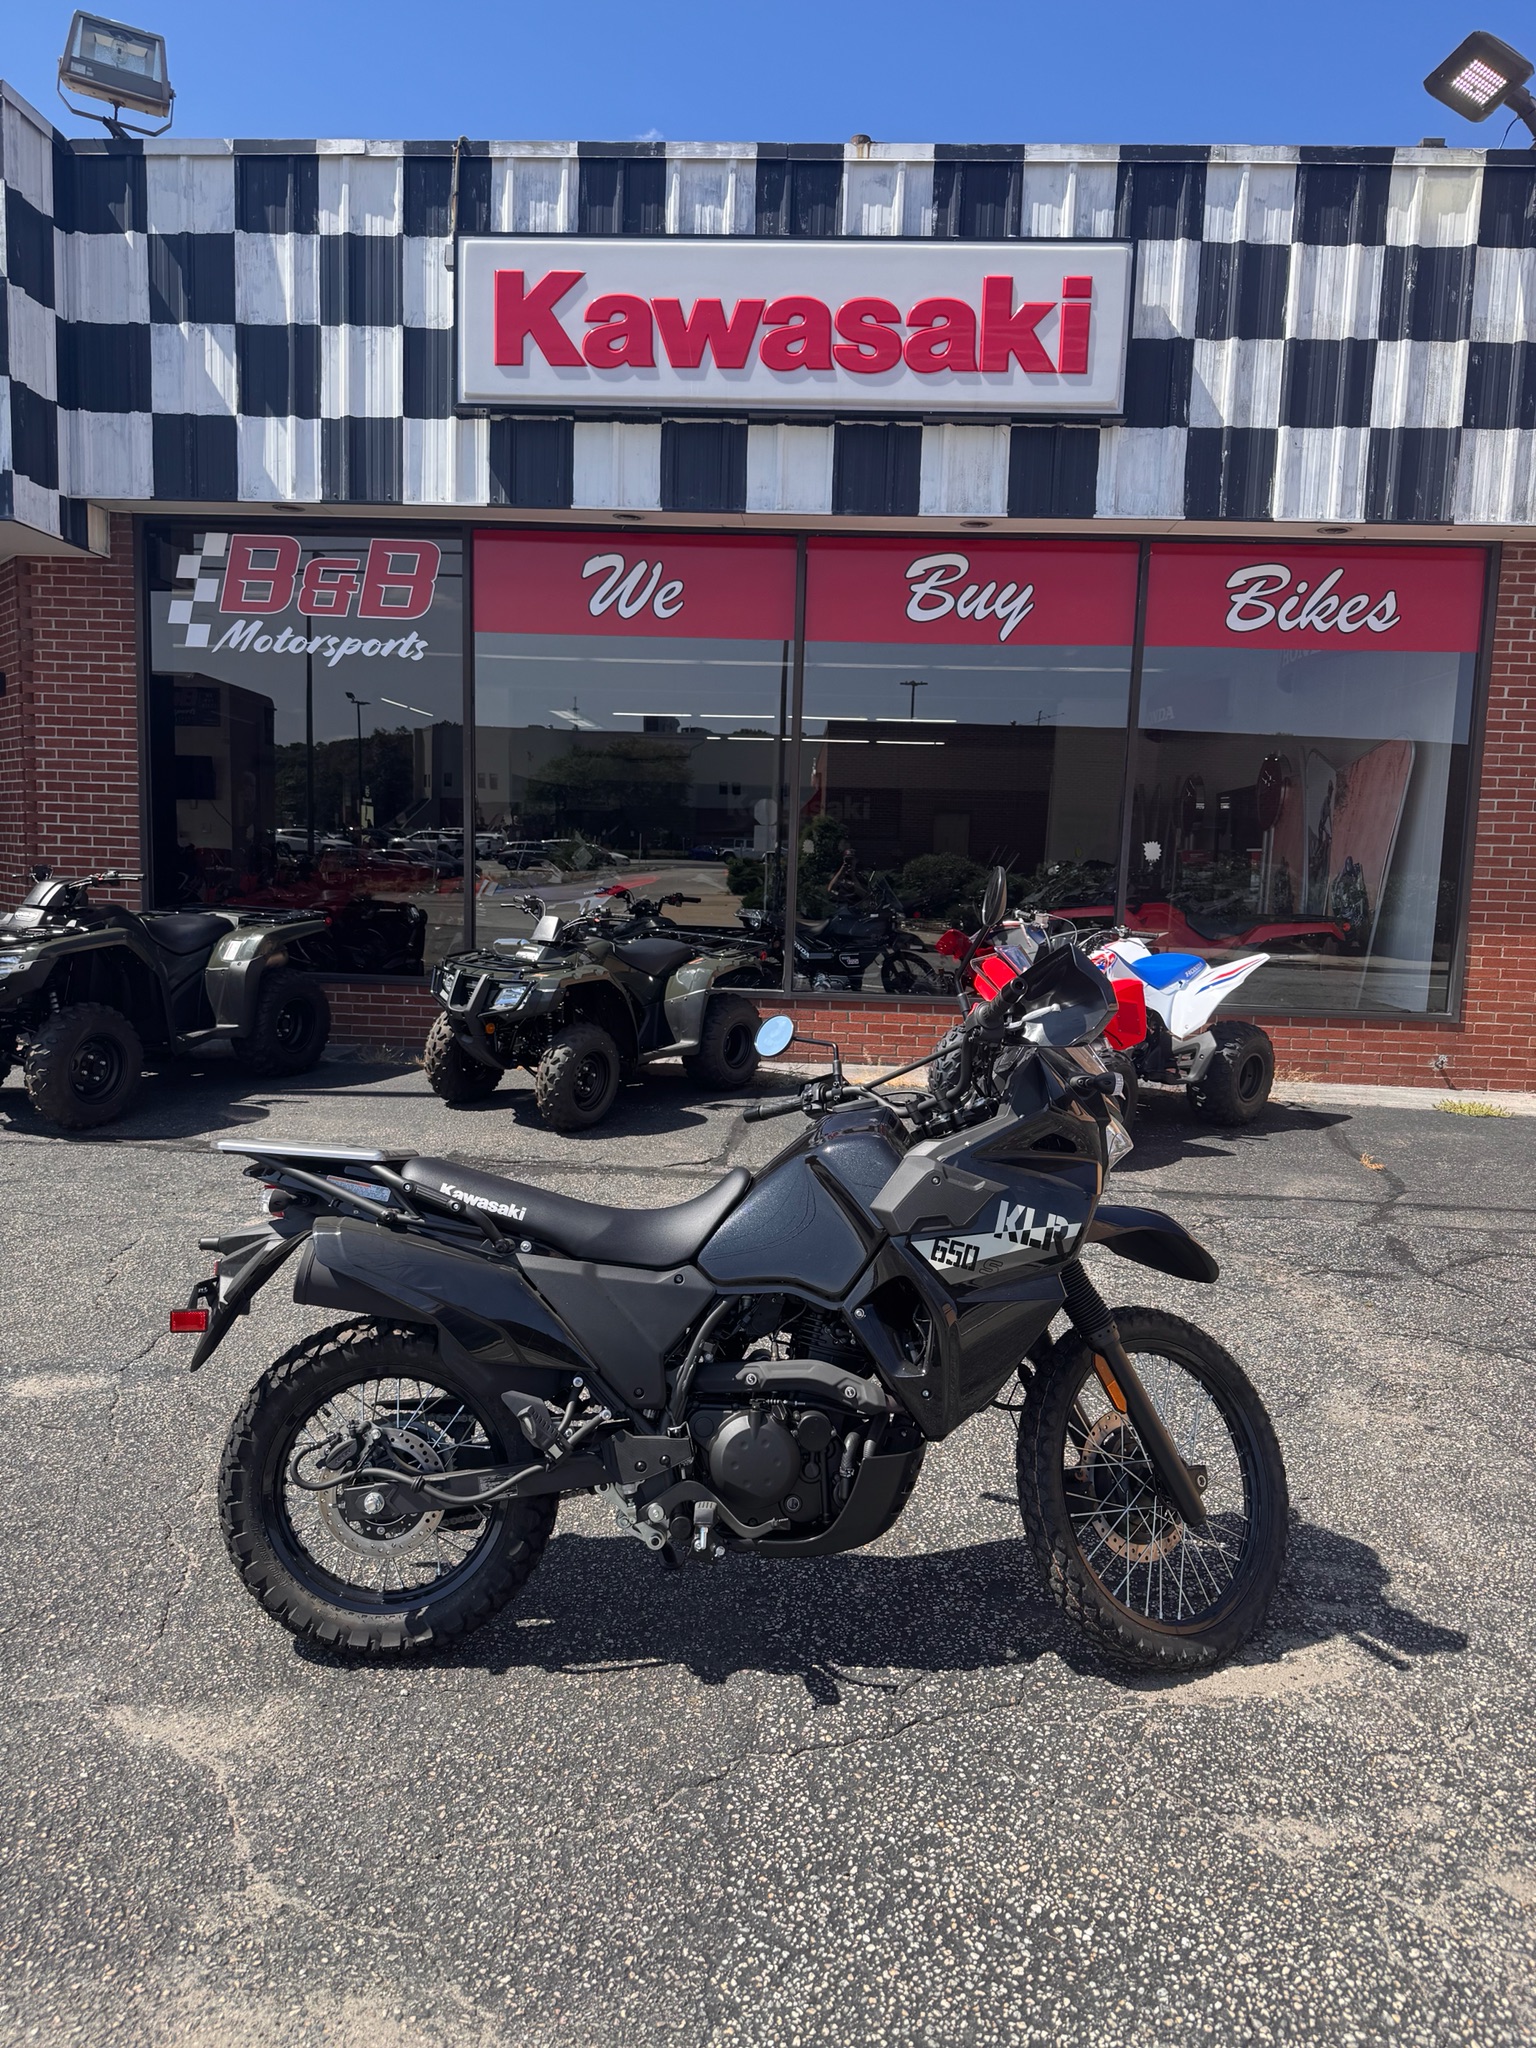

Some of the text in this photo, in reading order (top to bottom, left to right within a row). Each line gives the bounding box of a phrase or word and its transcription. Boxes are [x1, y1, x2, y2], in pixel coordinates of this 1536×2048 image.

[493, 269, 1093, 375] Kawasaki
[218, 533, 442, 619] B&B
[579, 551, 1402, 642] We Buy Bikes
[212, 618, 428, 667] Motorsports
[439, 1182, 528, 1222] Kawasaki
[993, 1200, 1069, 1259] KLR
[930, 1237, 981, 1272] 650
